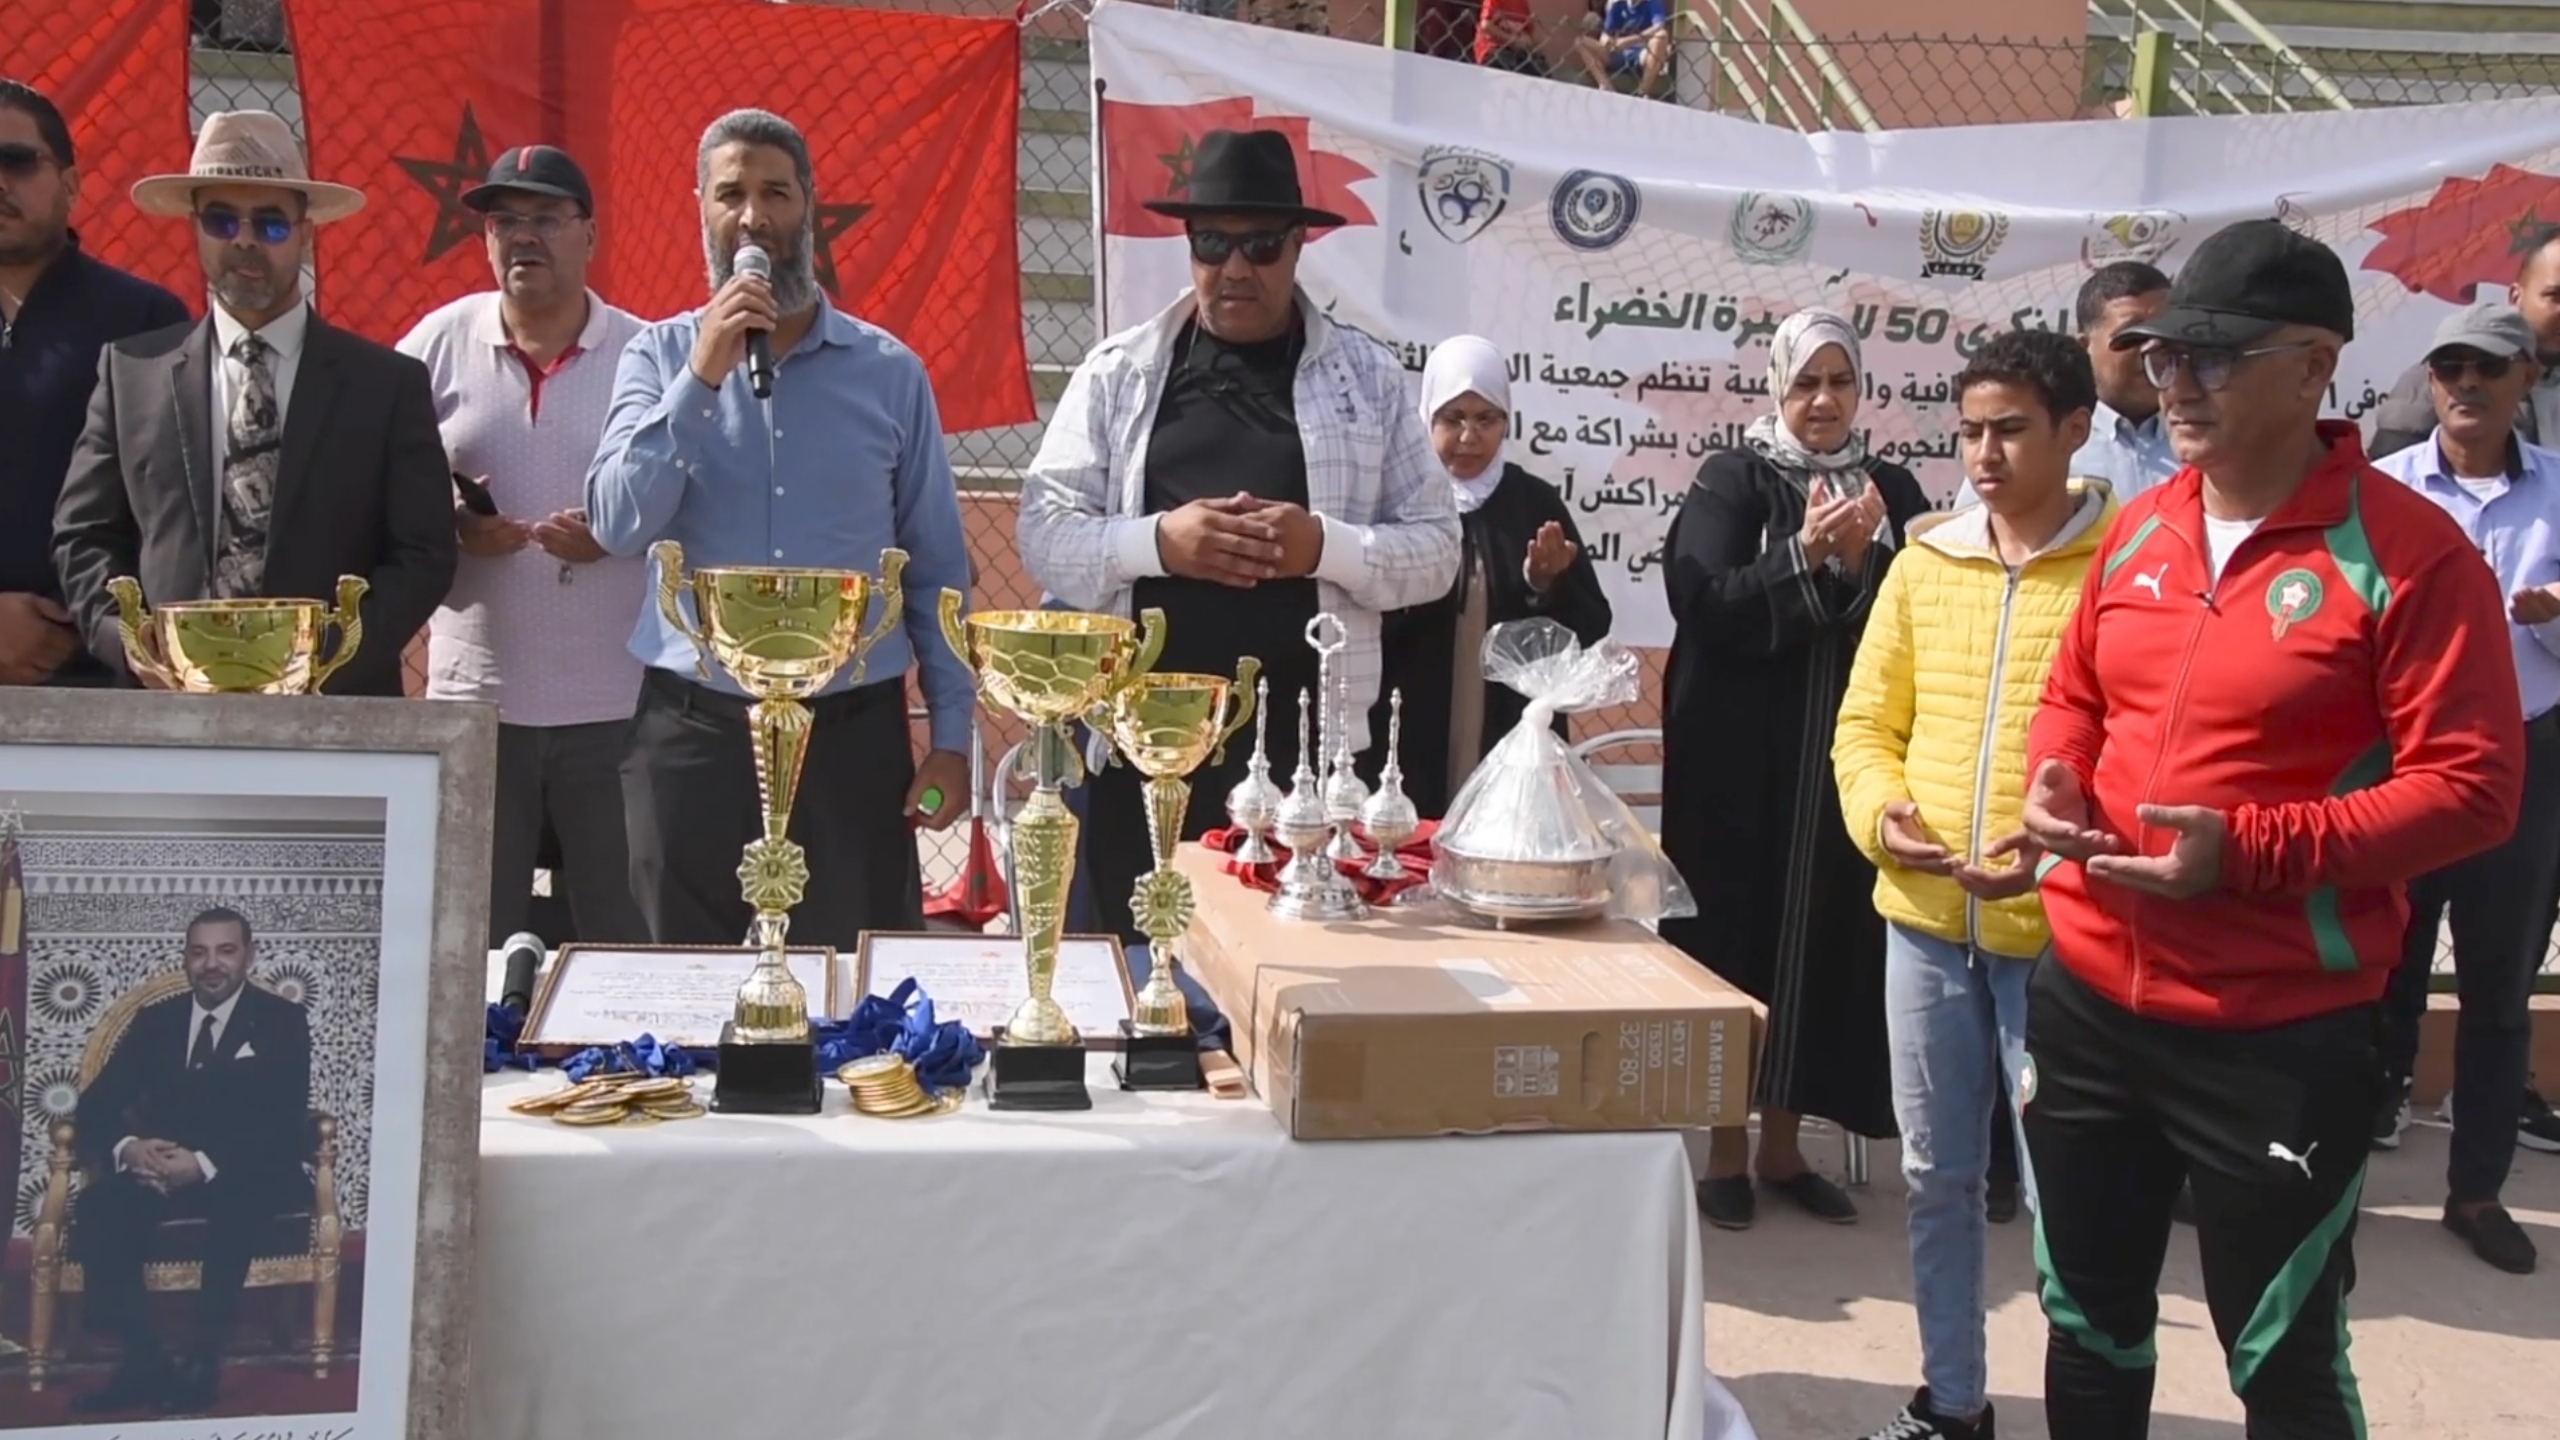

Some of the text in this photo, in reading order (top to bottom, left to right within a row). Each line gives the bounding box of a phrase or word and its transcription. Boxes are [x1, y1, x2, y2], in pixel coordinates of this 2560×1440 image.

[1554, 283, 1707, 340] الخضراء
[1884, 304, 1950, 345] 50
[1540, 353, 1630, 398] جمعية
[1637, 360, 1711, 402] تنظم
[1530, 420, 1568, 455] مع
[1575, 415, 1678, 459] بشراكة
[1579, 473, 1686, 516] مراكش
[1707, 1020, 1724, 1115] SAMSUNG
